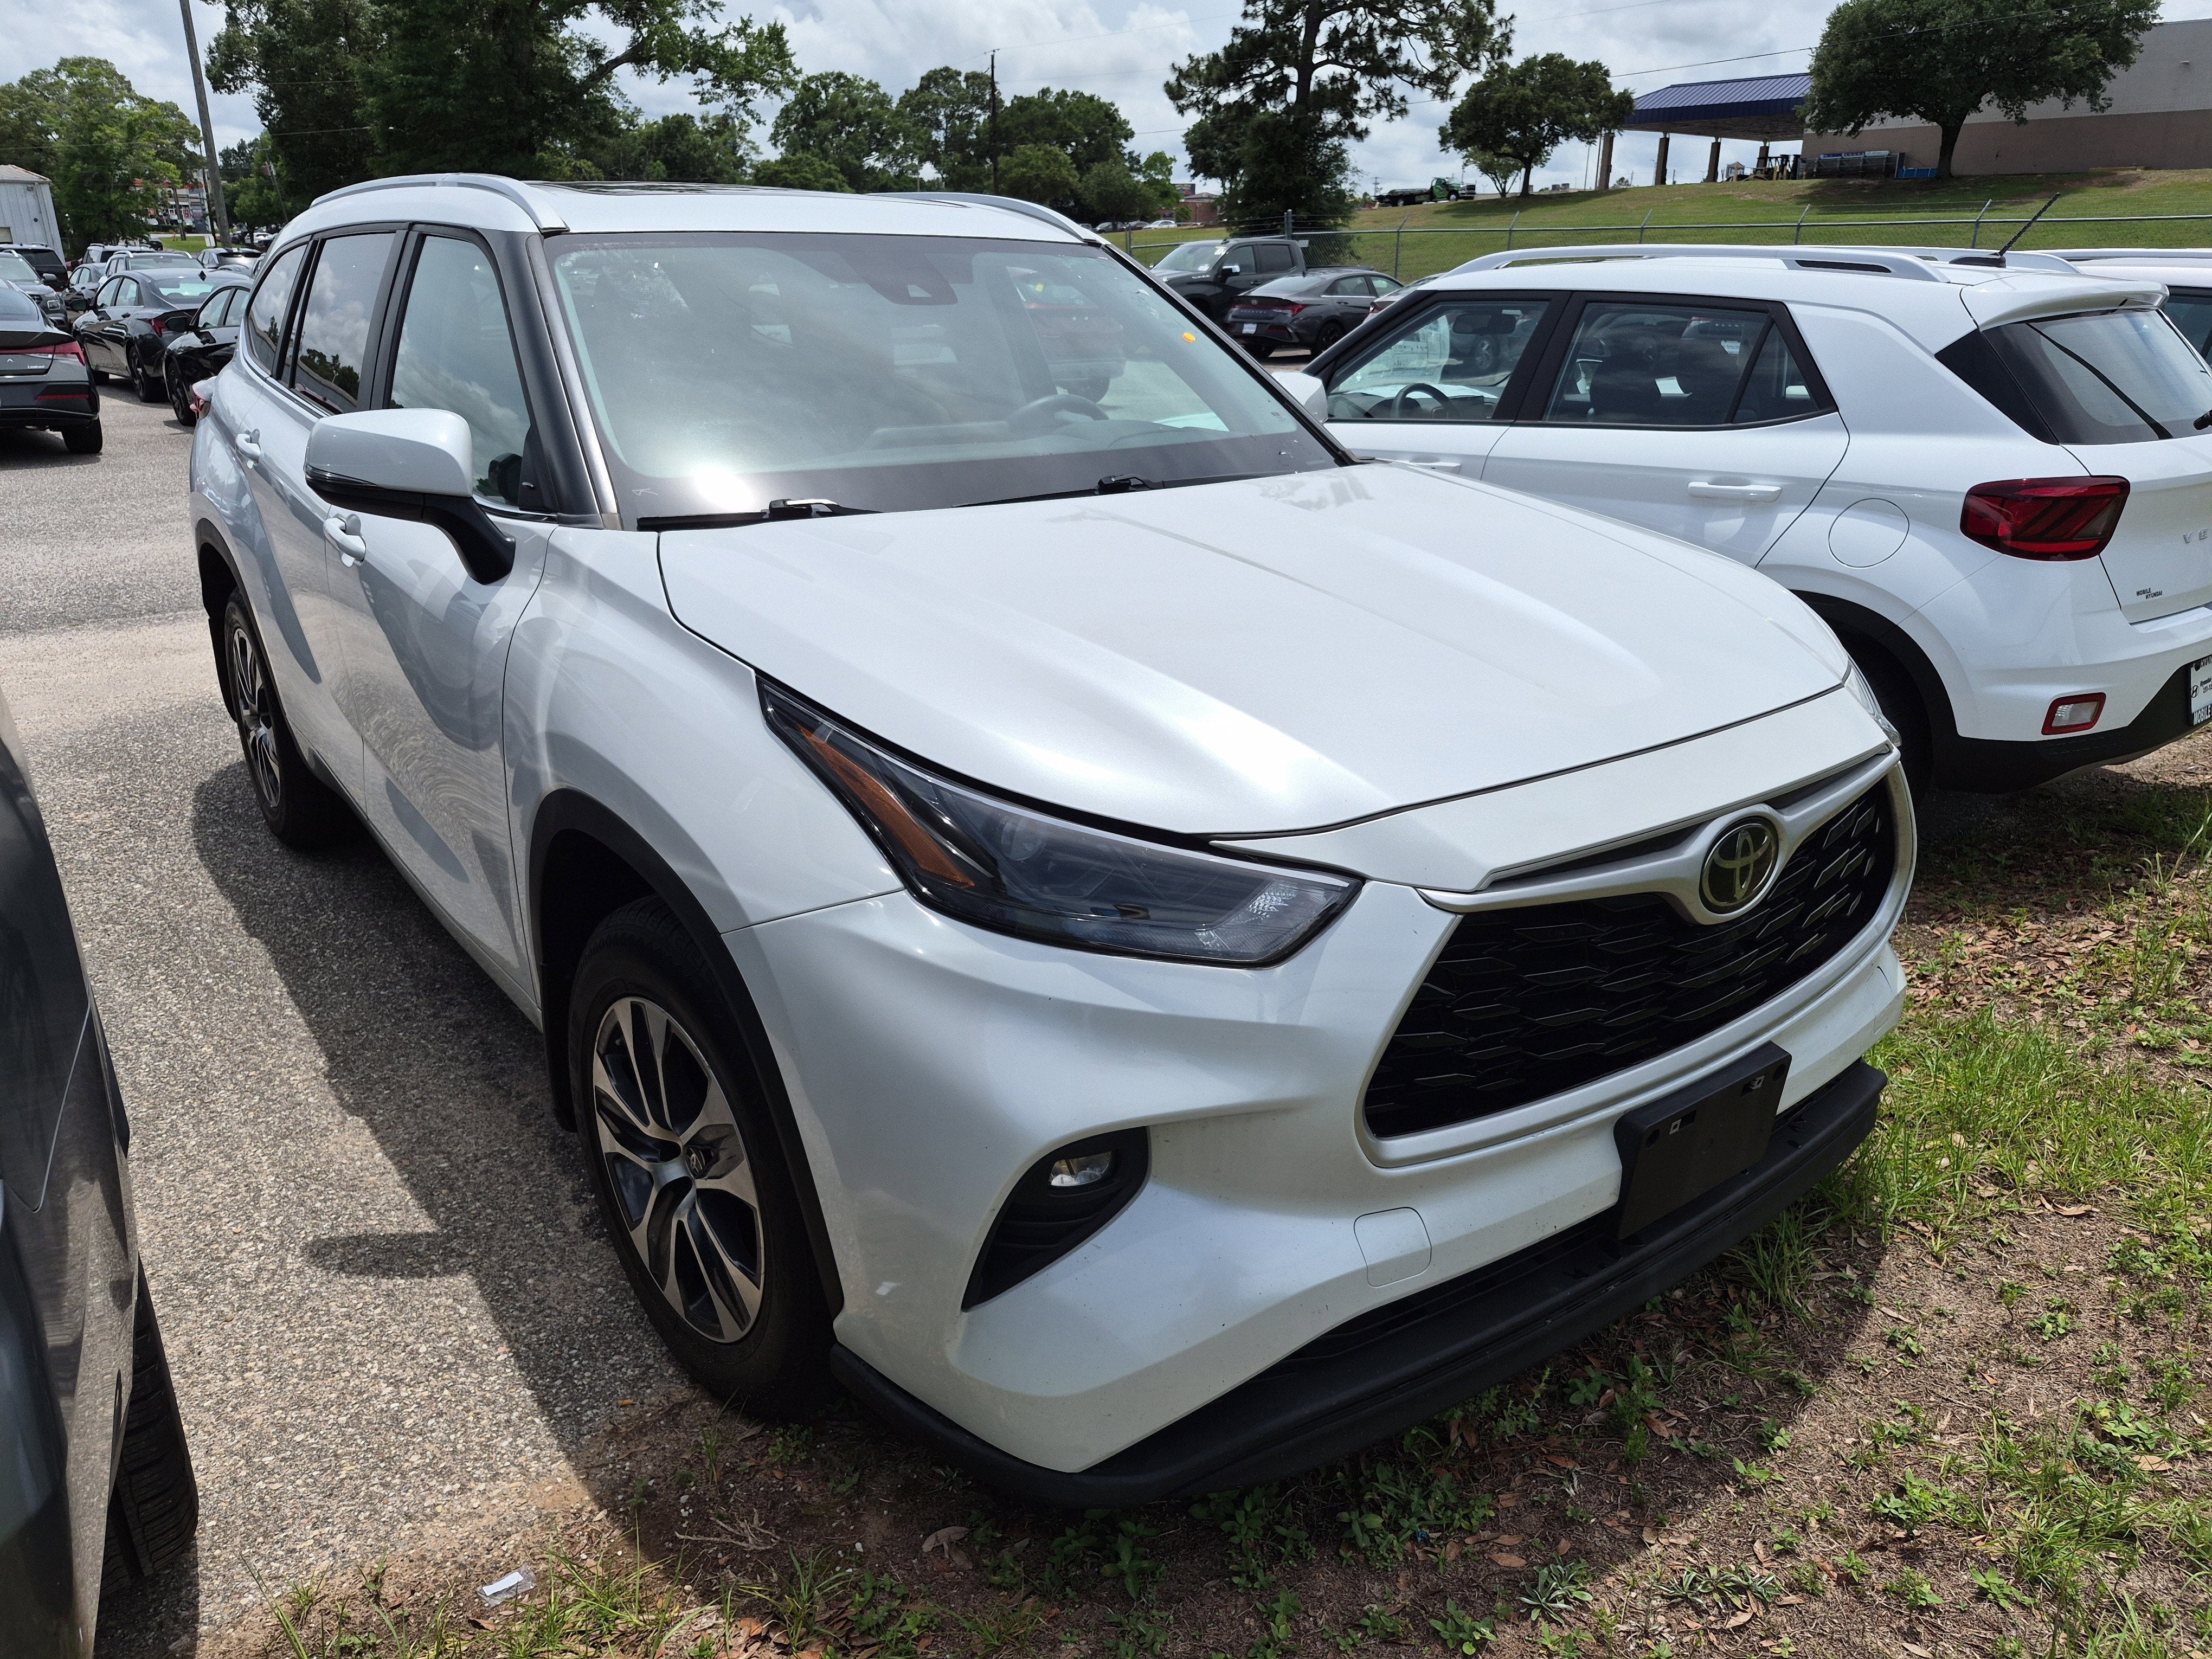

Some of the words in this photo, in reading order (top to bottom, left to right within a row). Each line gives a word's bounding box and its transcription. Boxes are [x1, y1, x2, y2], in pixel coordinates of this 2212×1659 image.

[2136, 587, 2151, 597] MOBILE
[2145, 590, 2163, 600] HYUNDAI
[2193, 704, 2211, 726] MOBILE
